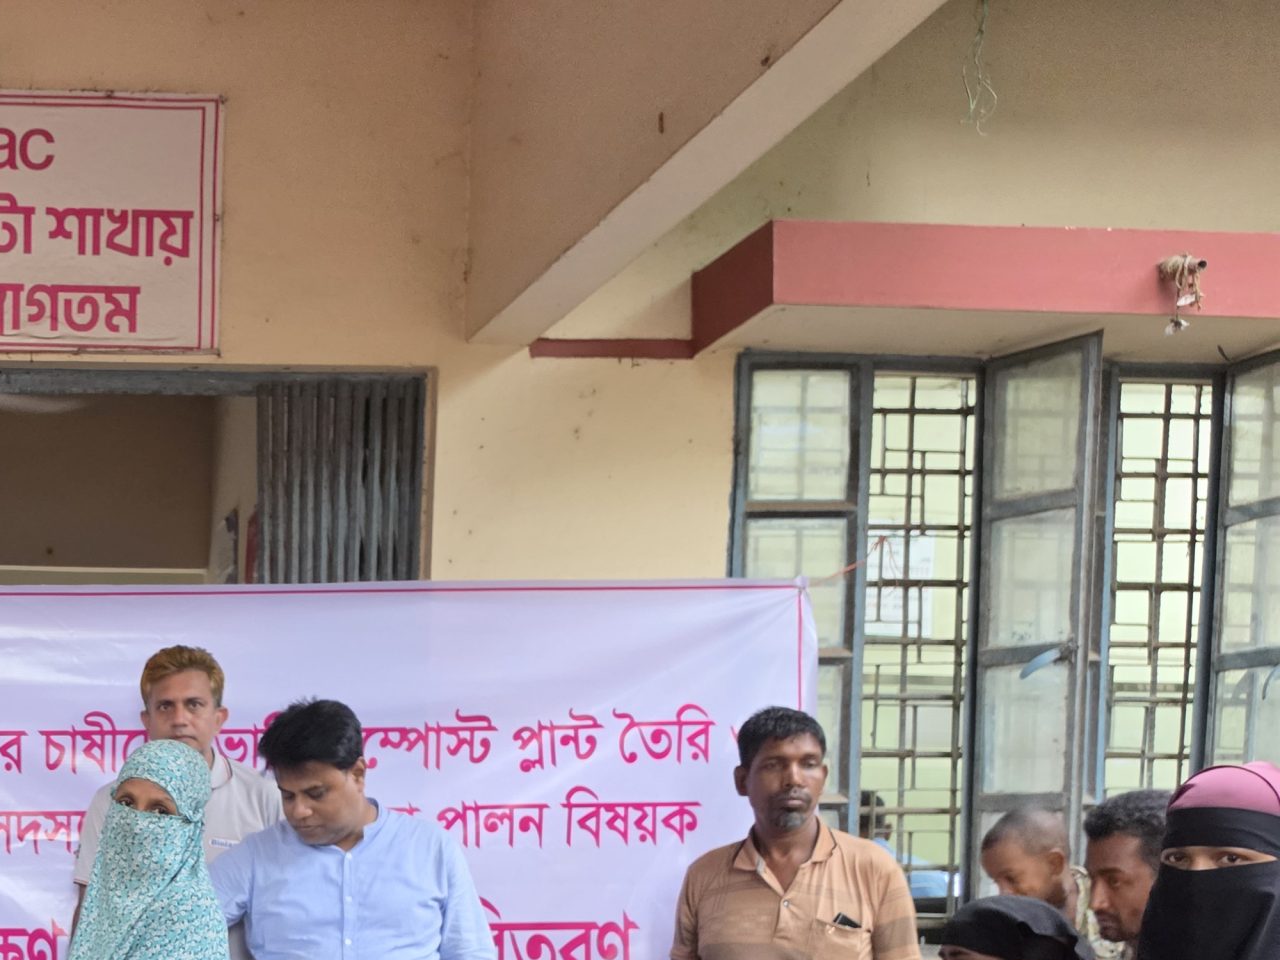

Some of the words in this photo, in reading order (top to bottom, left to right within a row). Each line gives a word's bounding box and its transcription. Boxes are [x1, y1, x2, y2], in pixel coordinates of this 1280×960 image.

[46, 206, 194, 266] শাখায়
[512, 708, 604, 773] প্লান্ট
[612, 703, 717, 765] তৈরি
[436, 800, 550, 849] পালন
[560, 785, 702, 848] বিষয়ক
